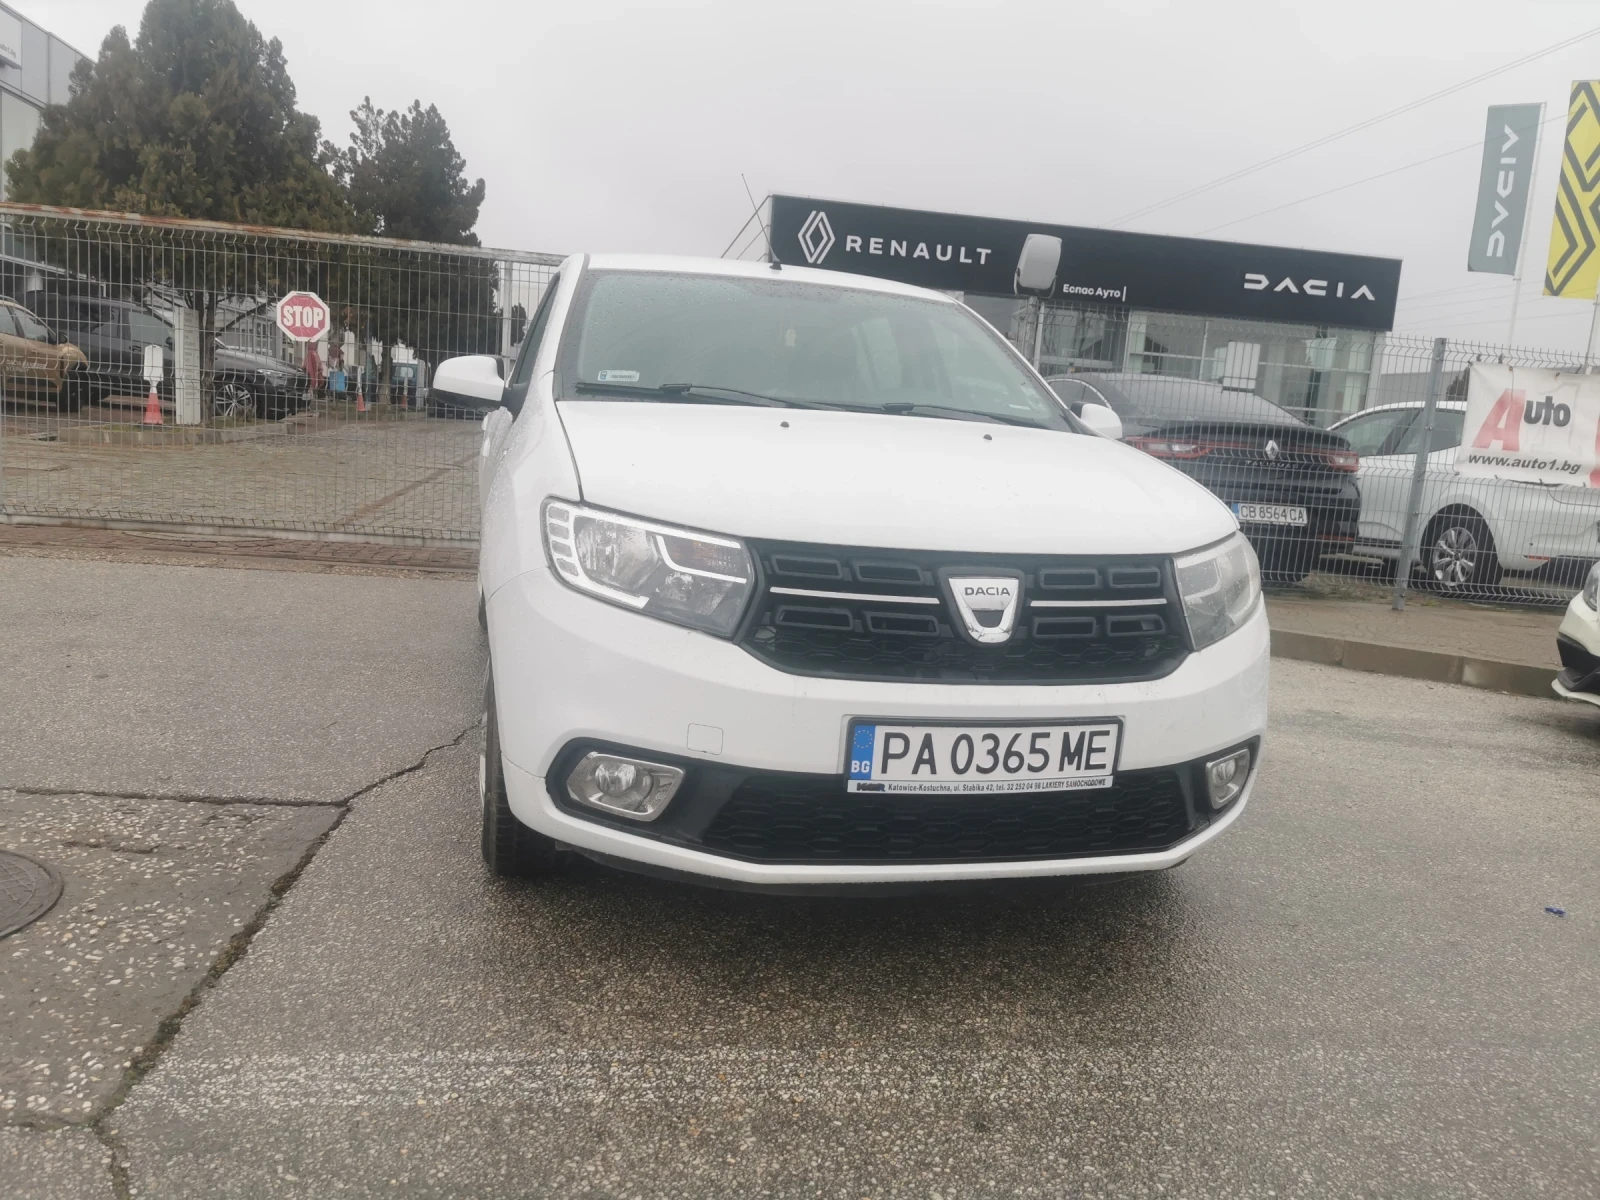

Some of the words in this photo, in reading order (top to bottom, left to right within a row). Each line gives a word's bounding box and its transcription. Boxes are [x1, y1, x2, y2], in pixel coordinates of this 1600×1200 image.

[1486, 124, 1519, 258] DACIA
[845, 234, 992, 265] RENAULT
[1062, 283, 1095, 296] Еспас
[1095, 286, 1121, 299] Ауто
[1243, 273, 1376, 301] DACIA
[283, 305, 324, 329] STOP
[1471, 387, 1571, 453] Auto
[1468, 454, 1582, 475] www.auto1.bg
[1258, 506, 1288, 521] 8564
[964, 586, 1011, 596] DACIA
[880, 731, 938, 775] PA
[950, 731, 1051, 775] 0365
[1058, 729, 1111, 772] ME
[850, 760, 871, 773] BG
[1041, 780, 1064, 789] LAKIERY
